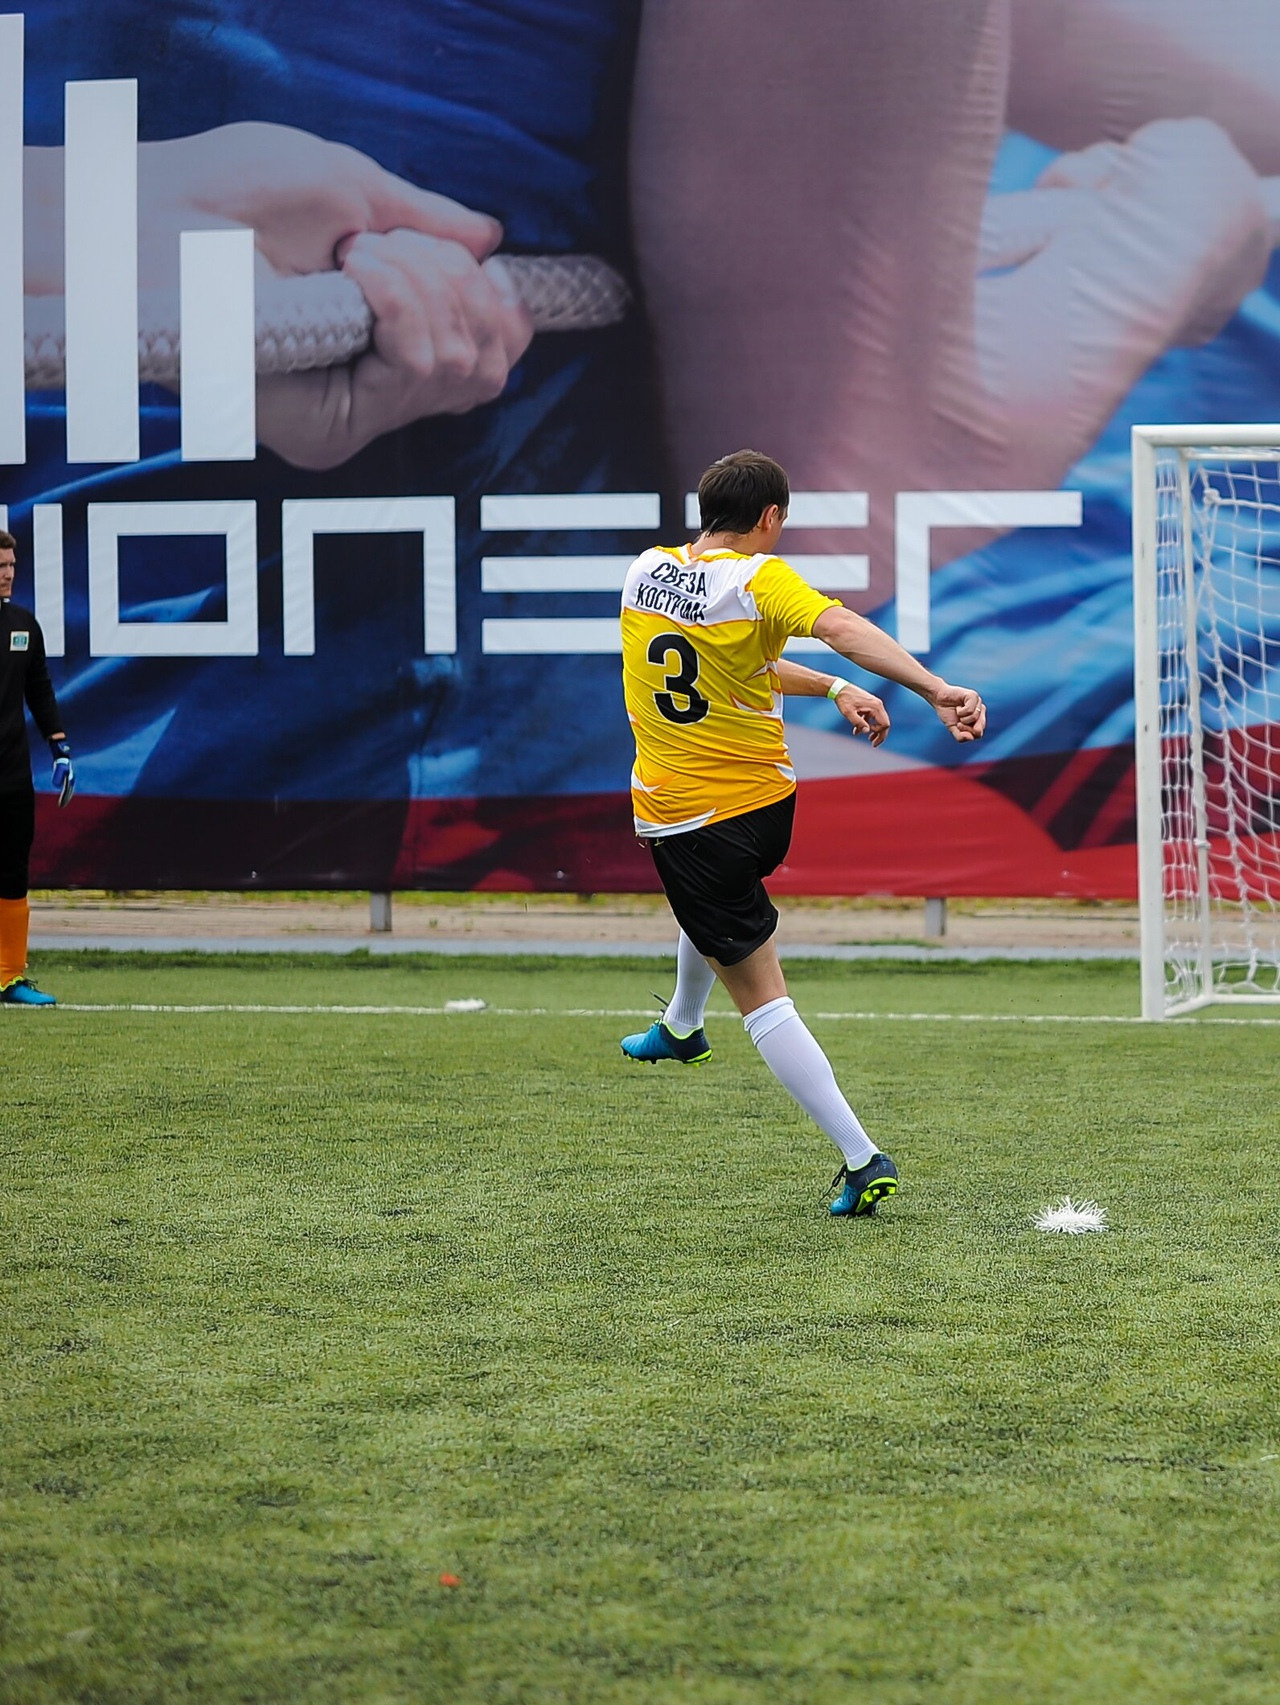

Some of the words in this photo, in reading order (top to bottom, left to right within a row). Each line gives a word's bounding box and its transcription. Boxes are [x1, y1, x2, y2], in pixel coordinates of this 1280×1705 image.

[650, 562, 707, 597] СВЕЗА
[636, 582, 708, 622] КОСТРОМА
[646, 632, 709, 725] 3
